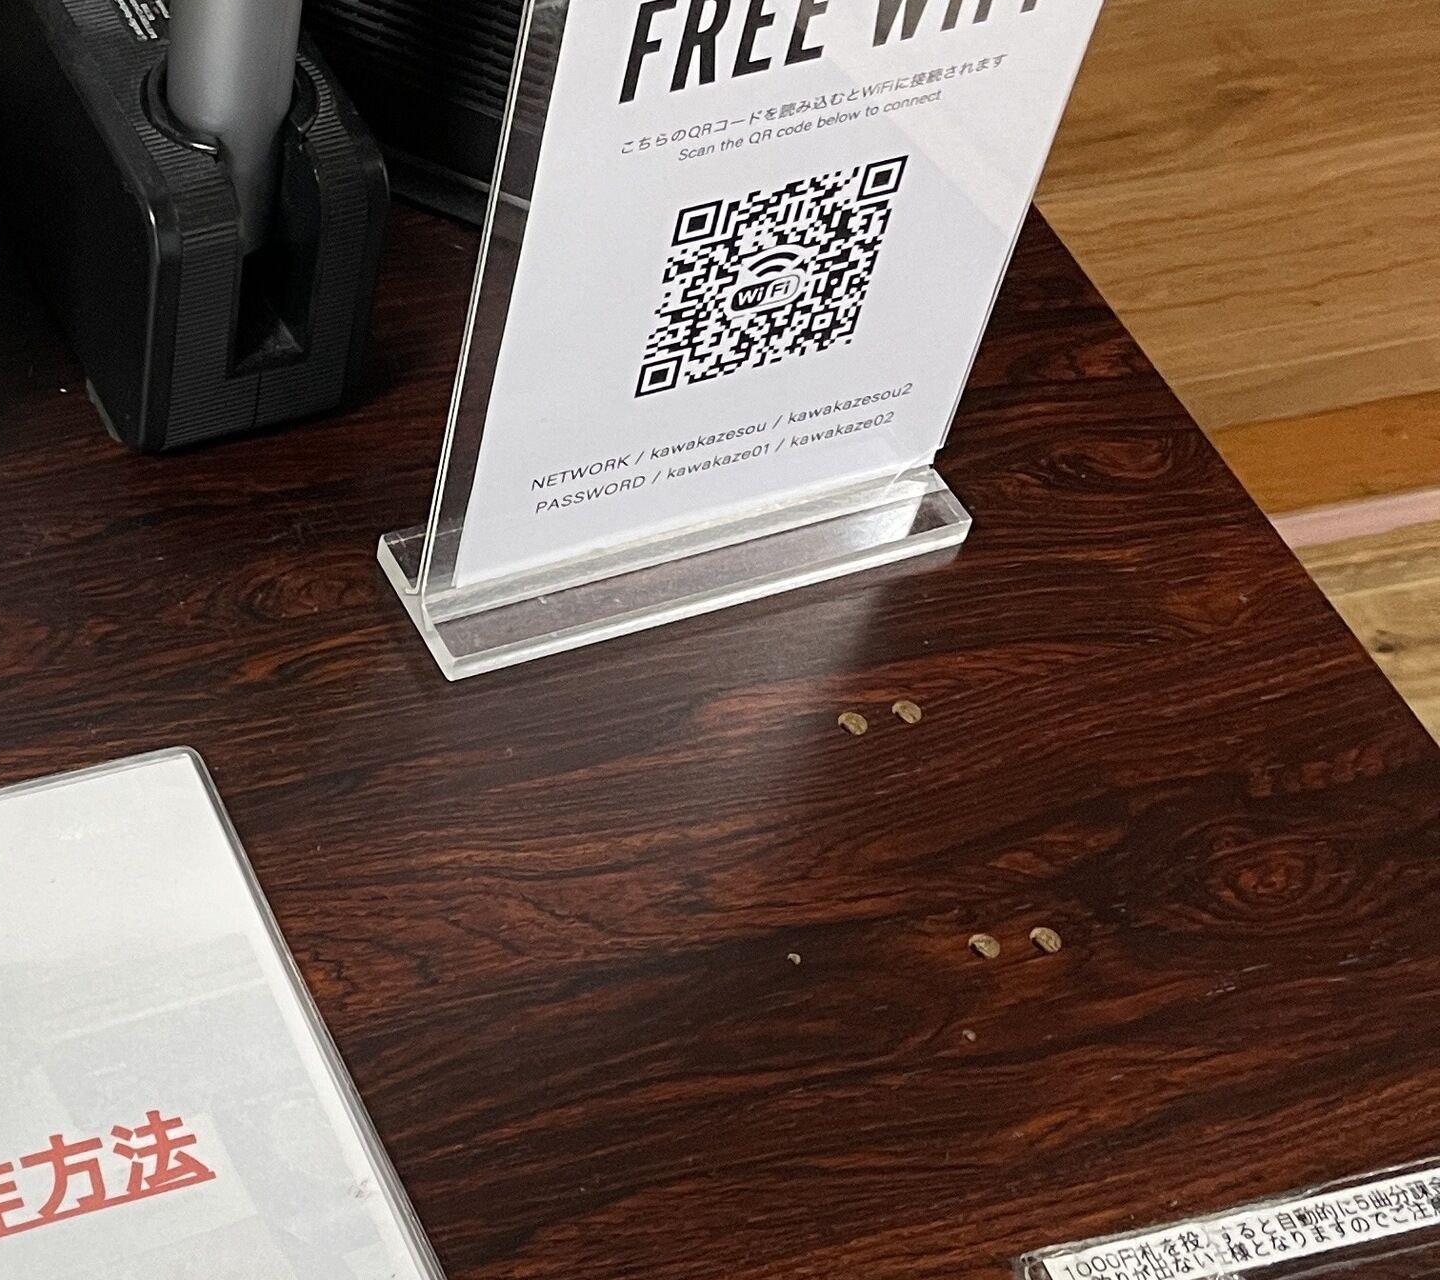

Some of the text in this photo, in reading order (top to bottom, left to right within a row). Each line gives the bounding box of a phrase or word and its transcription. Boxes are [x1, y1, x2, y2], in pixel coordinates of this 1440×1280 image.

[620, 53, 1009, 156] こちらのQRコードを読み込むとWiFiに接続されます
[678, 90, 943, 162] Scan the QR code below to connect
[530, 453, 631, 492] NETWORK
[649, 422, 768, 461] kawakazesou
[787, 382, 914, 425] kawakazesou2
[535, 475, 646, 514] PASSWORD
